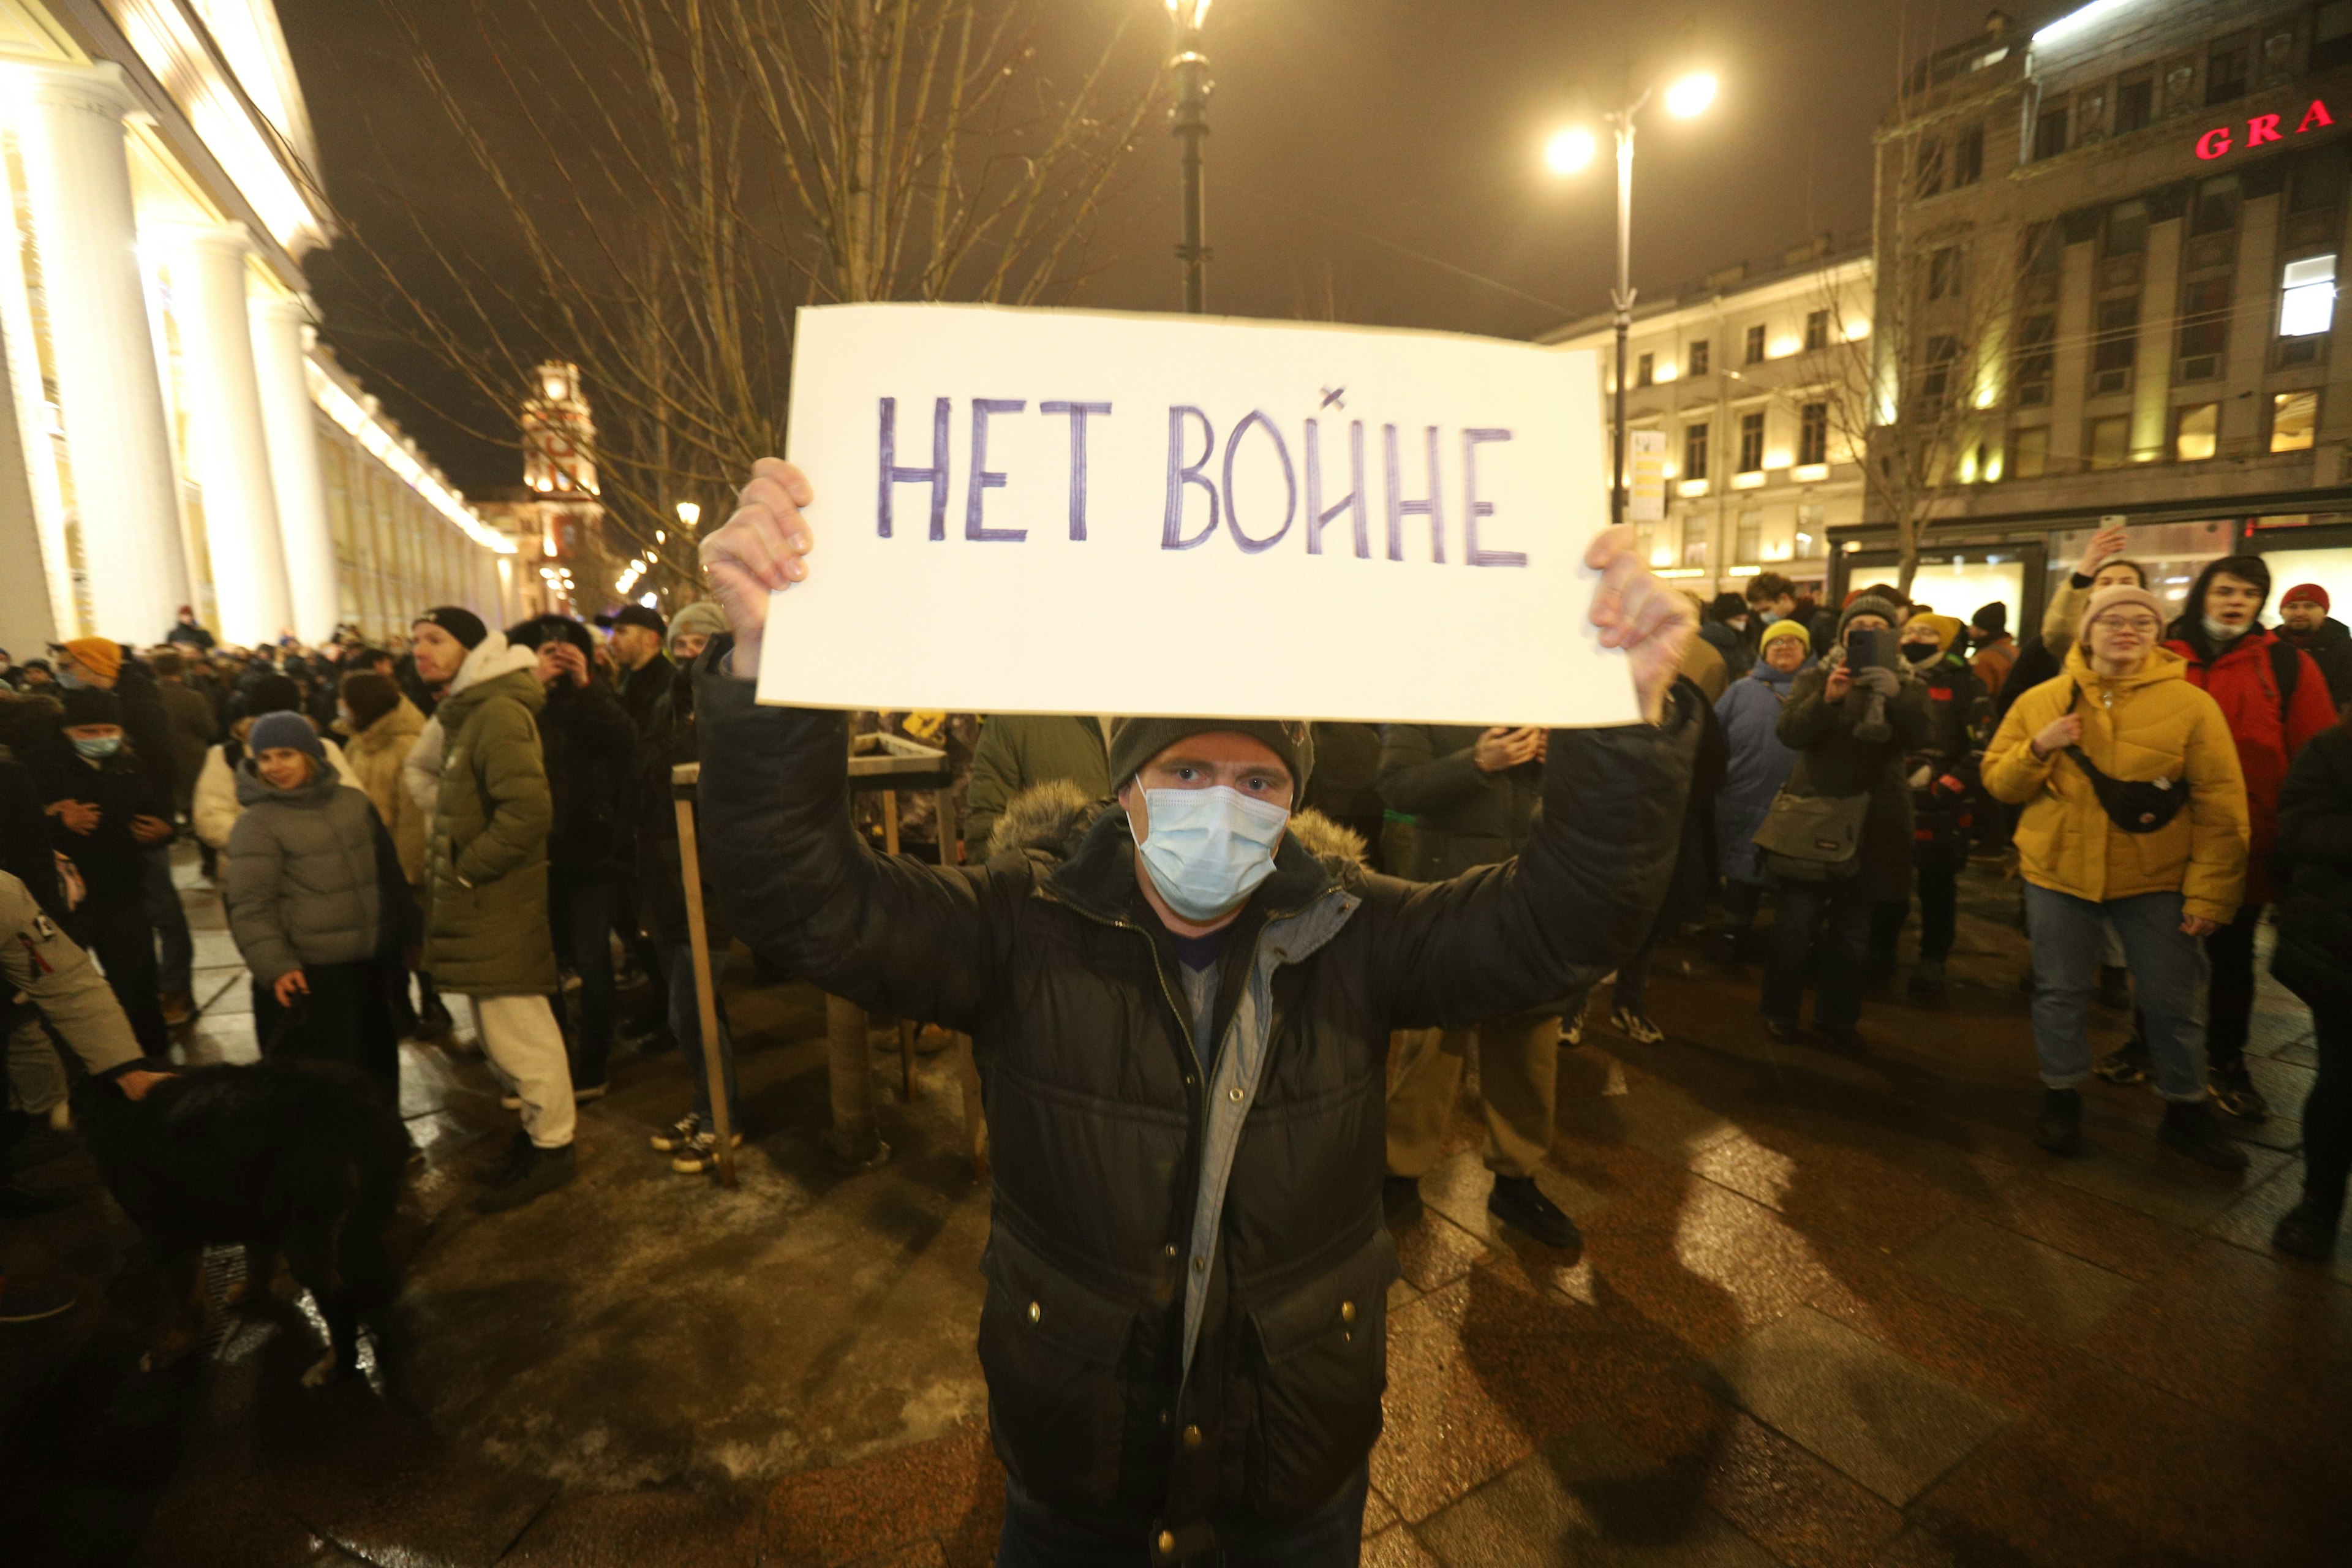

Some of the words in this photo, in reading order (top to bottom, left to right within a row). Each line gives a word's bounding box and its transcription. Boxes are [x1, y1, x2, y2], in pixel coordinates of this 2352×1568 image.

[2195, 99, 2352, 160] GRA
[876, 397, 1114, 542] НЕТ
[1160, 388, 1528, 568] ВОЙНЕ
